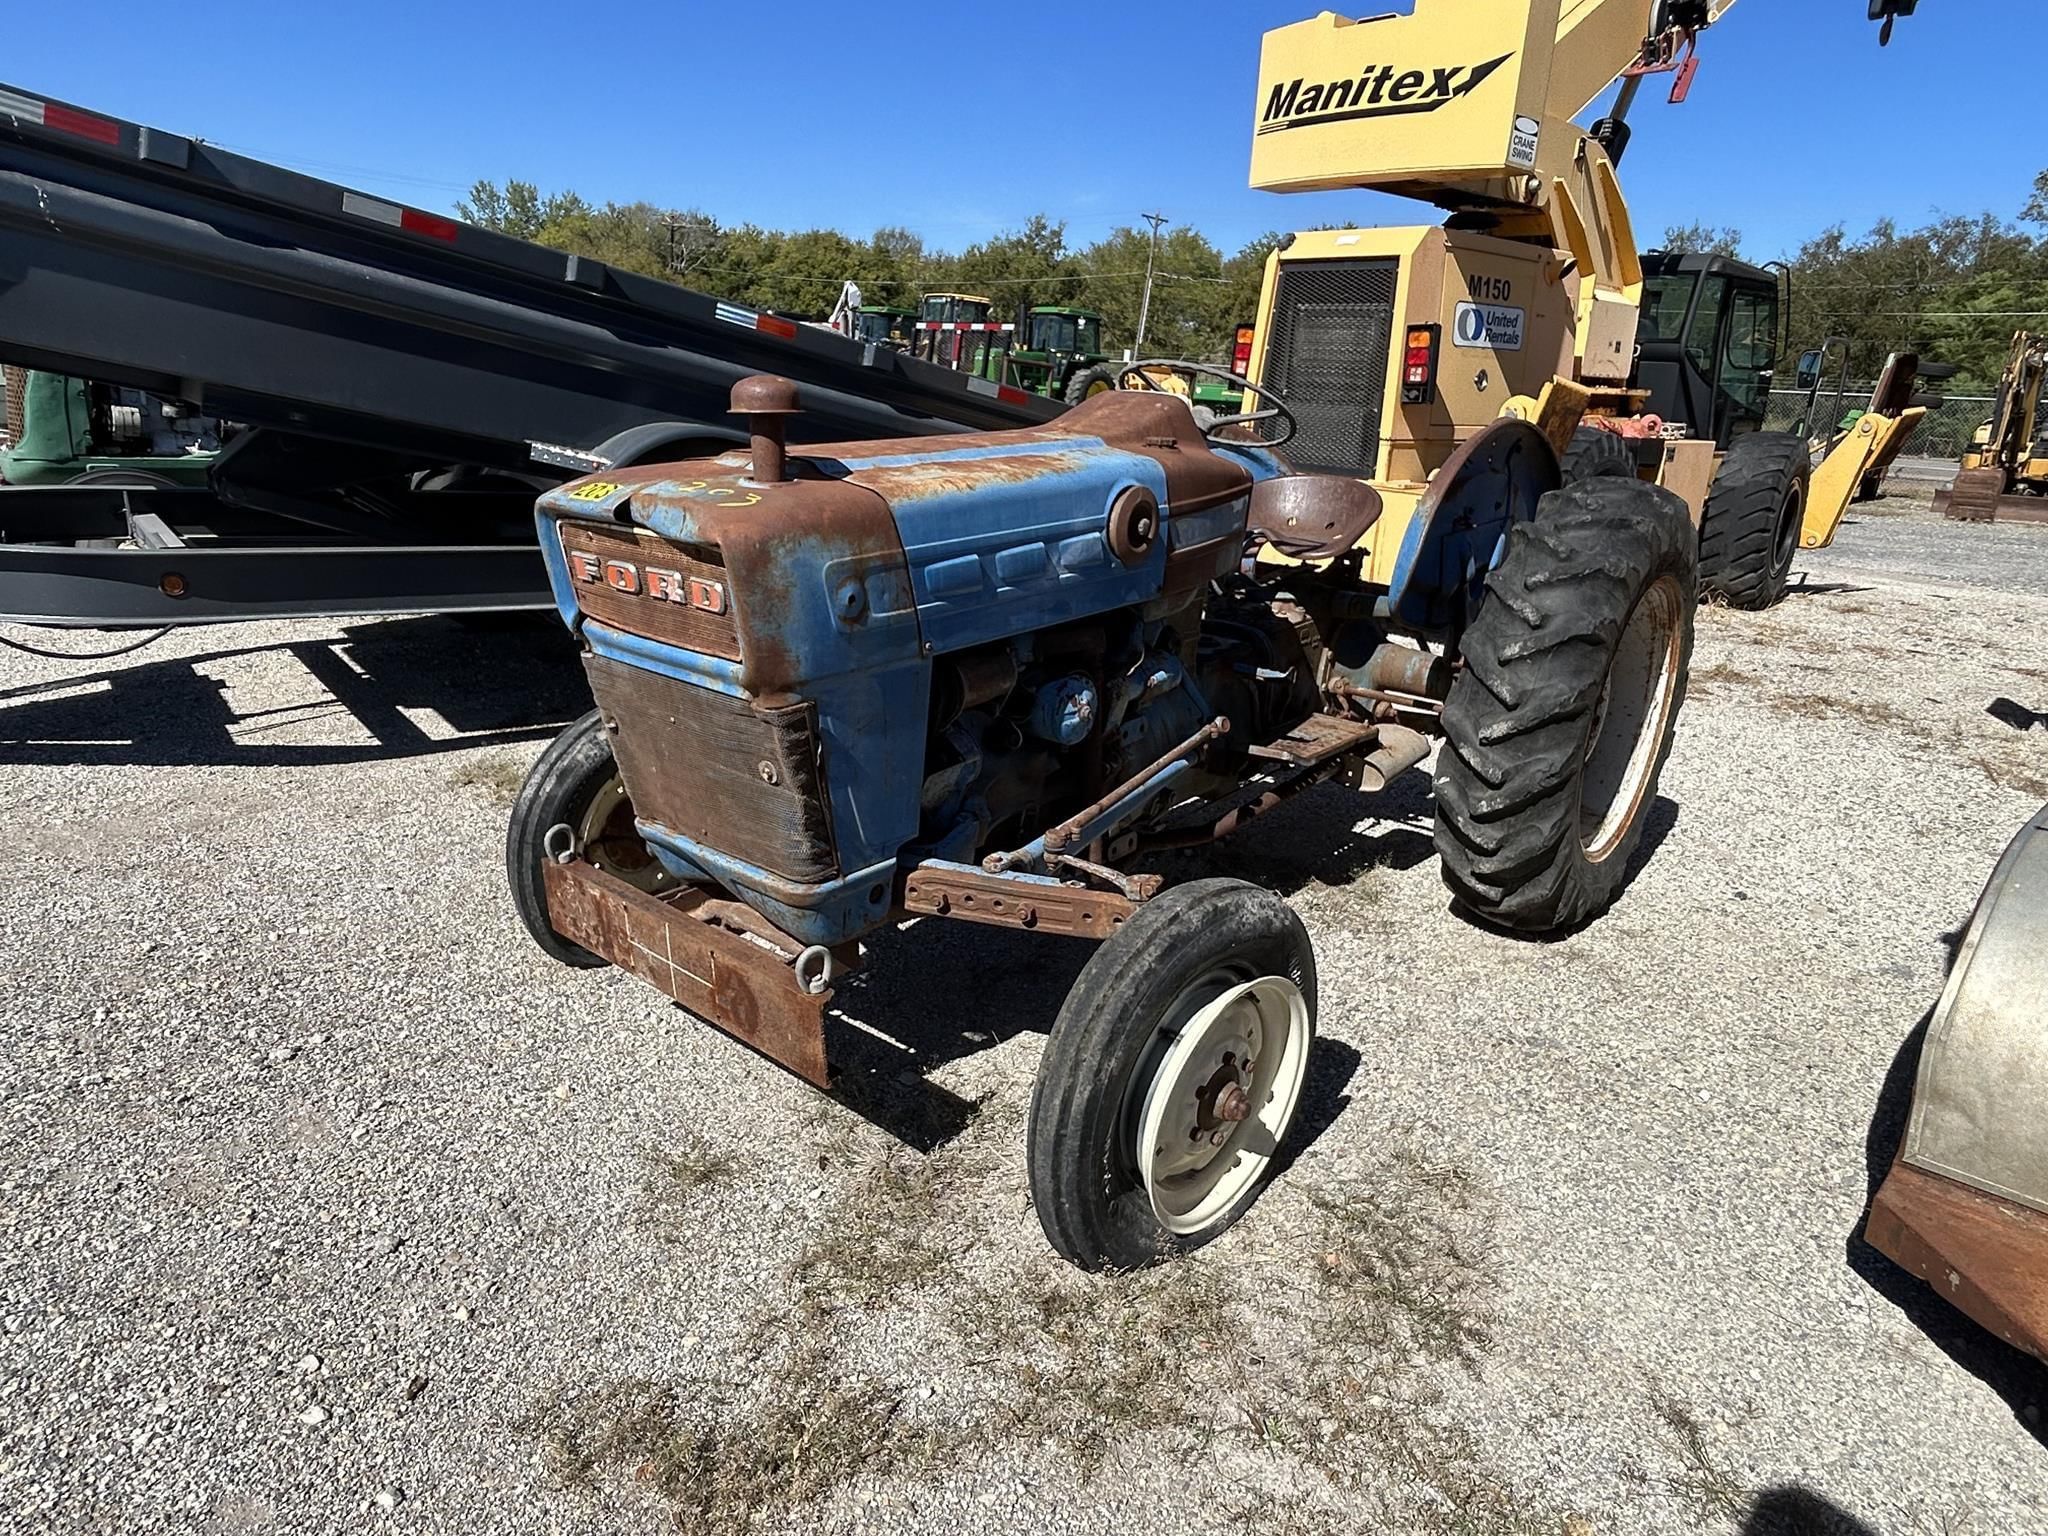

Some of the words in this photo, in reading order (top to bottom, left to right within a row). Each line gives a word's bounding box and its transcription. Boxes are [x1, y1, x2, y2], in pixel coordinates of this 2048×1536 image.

[1263, 64, 1467, 122] Manitex
[1513, 135, 1536, 151] CRANE
[1511, 147, 1533, 162] SWING
[1468, 274, 1511, 302] M150
[1486, 311, 1520, 329] United
[1484, 328, 1520, 345] Rentals
[678, 481, 763, 507] 203
[571, 550, 728, 617] FORD
